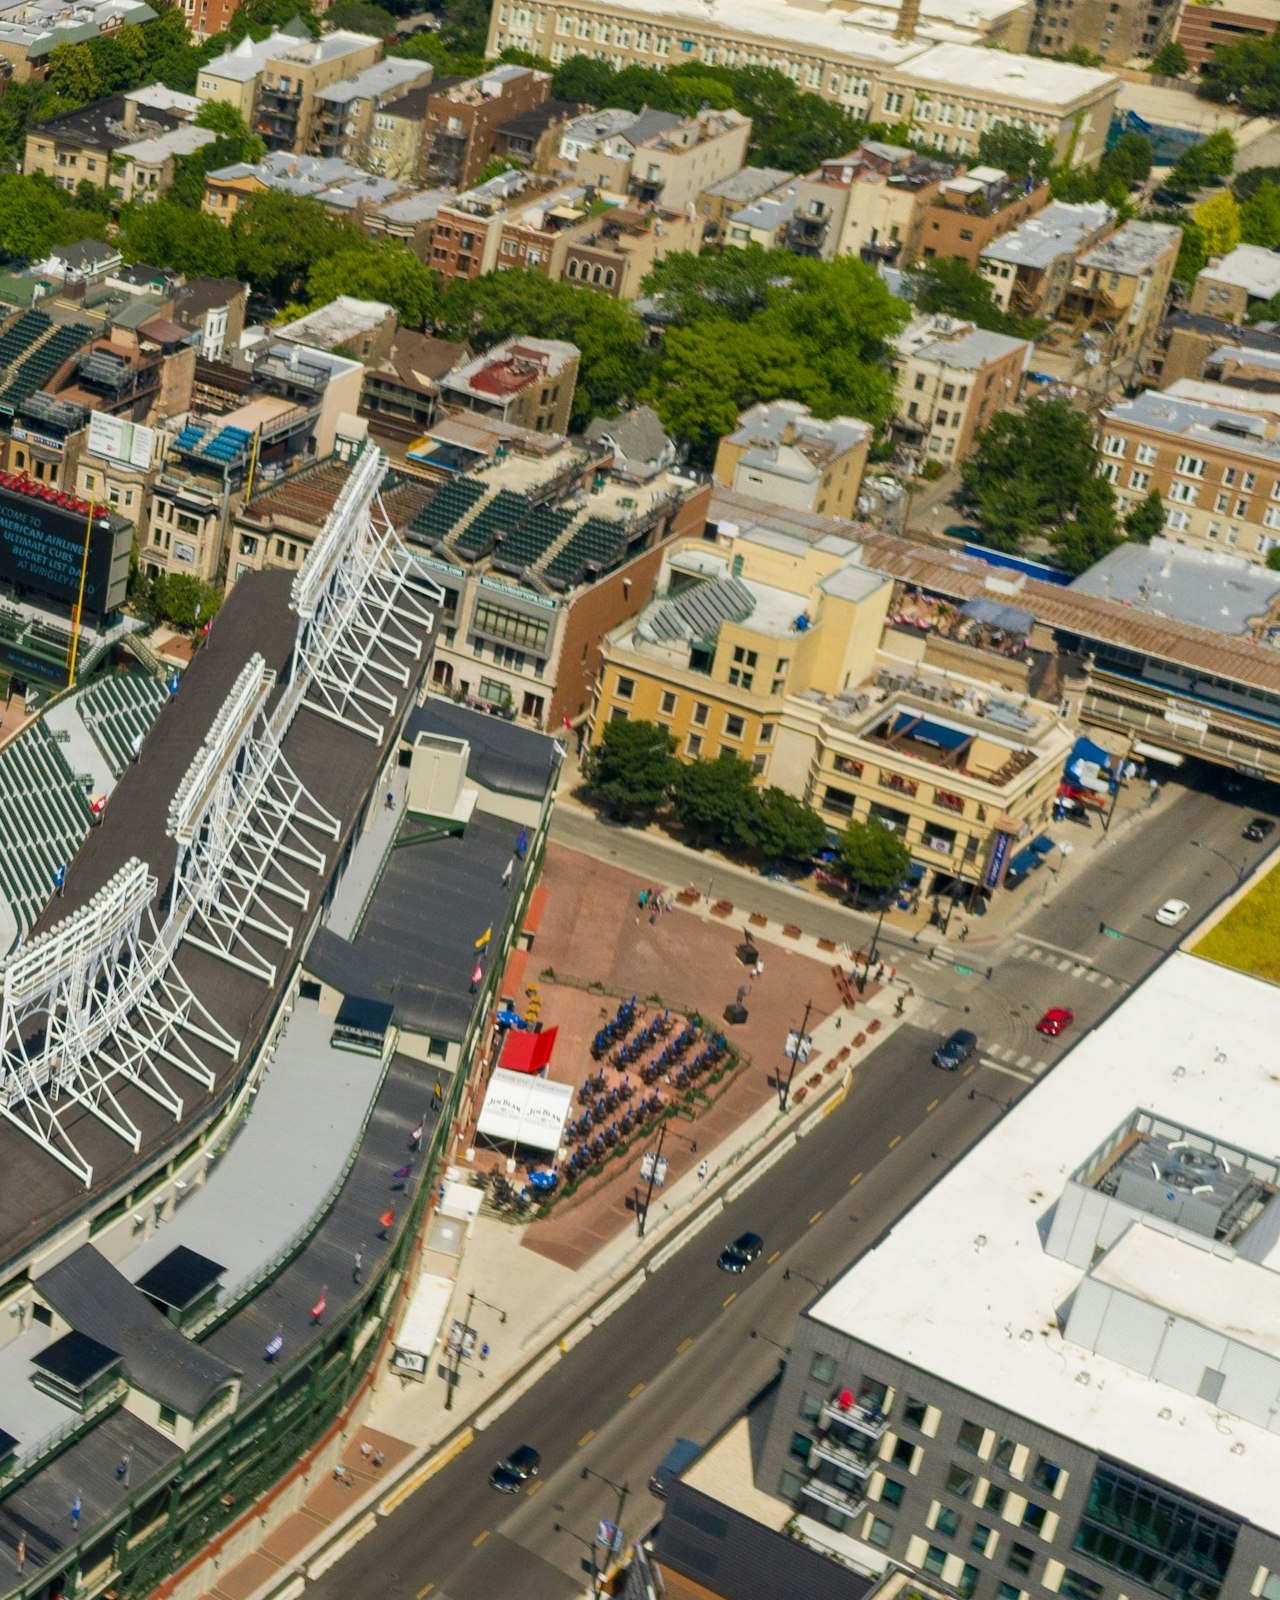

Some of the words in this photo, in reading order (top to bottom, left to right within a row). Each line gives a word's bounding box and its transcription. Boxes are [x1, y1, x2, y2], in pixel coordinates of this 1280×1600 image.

[29, 516, 42, 528] TO
[3, 531, 47, 554] ULTIMATE
[49, 543, 74, 563] CUBS
[12, 546, 48, 567] BUCKET
[49, 557, 67, 572] LIST
[68, 564, 89, 579] DA
[17, 560, 28, 571] AT
[29, 564, 70, 588] WRIGLEY
